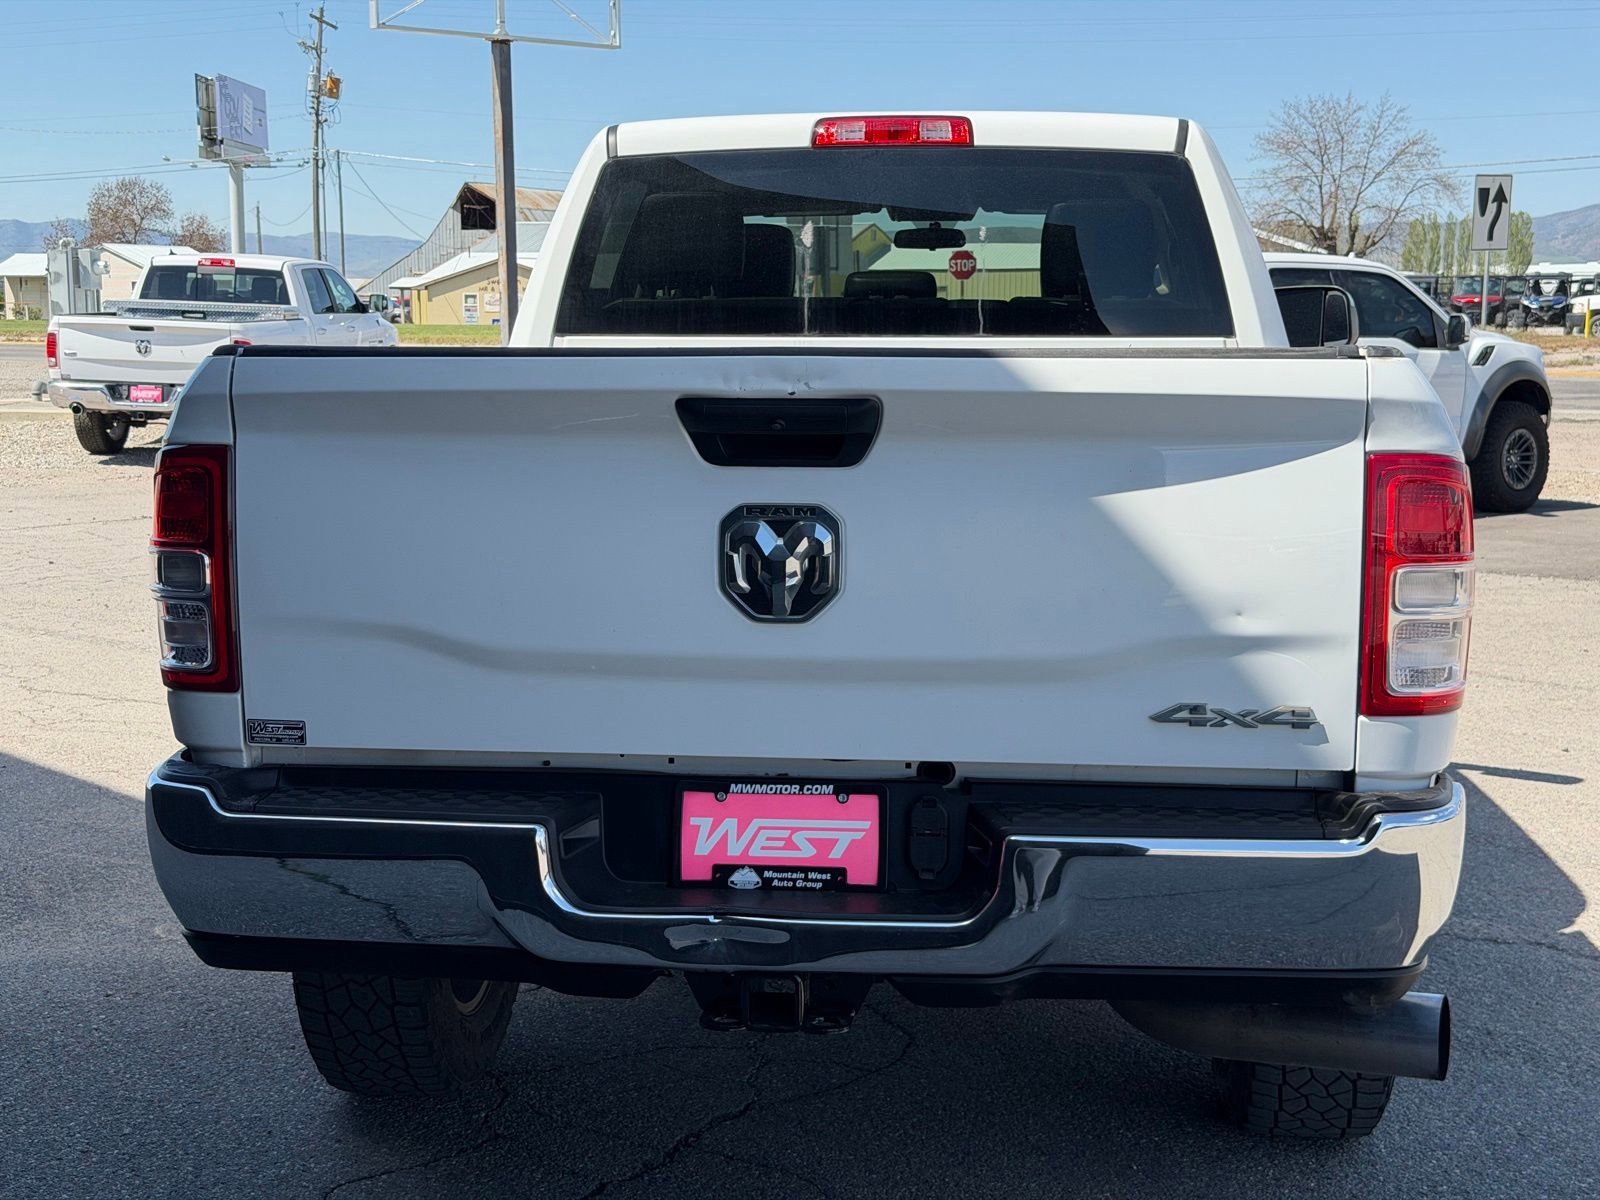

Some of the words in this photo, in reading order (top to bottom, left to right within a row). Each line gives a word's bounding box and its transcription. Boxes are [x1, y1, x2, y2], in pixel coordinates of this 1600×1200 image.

[950, 259, 975, 272] STOP
[743, 506, 817, 518] RAM
[729, 783, 834, 795] MWMOTOR.COM
[689, 816, 872, 859] WEST
[763, 870, 805, 879] Mountain
[808, 871, 831, 880] West
[772, 879, 793, 887] Auto
[796, 880, 823, 890] Group
